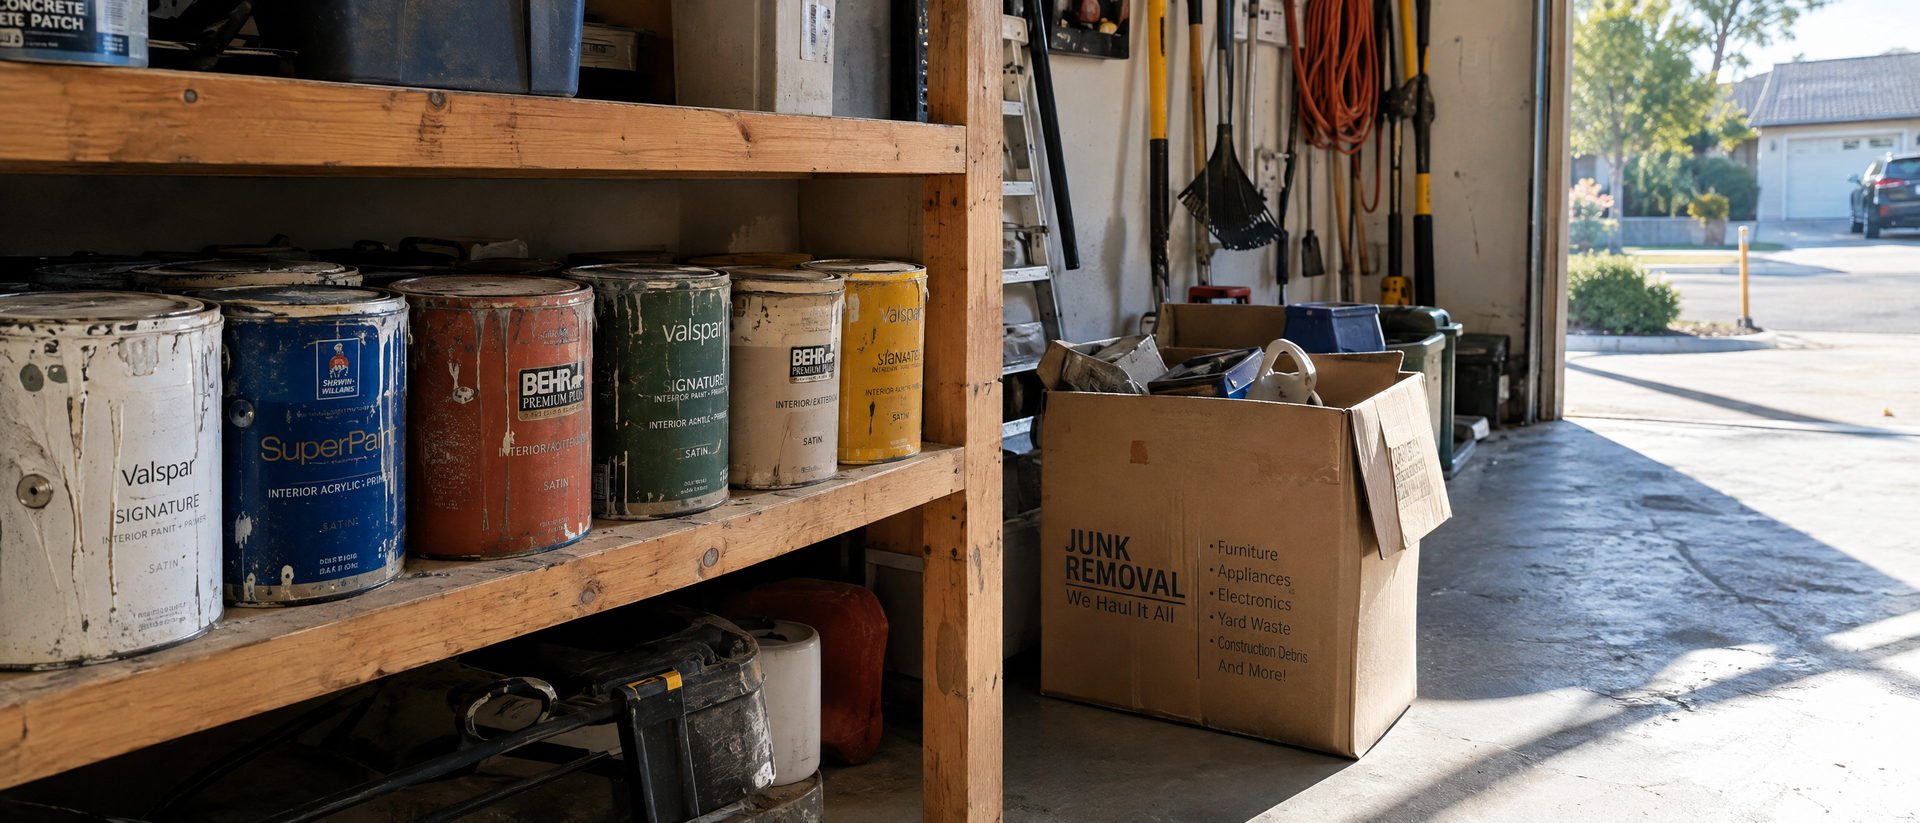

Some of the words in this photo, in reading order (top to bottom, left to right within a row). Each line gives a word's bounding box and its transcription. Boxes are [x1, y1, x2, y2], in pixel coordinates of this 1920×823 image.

[31, 13, 84, 31] PATCH
[792, 347, 825, 366] BEHR
[522, 368, 571, 396] BEHR
[523, 393, 567, 408] PREMIUM
[569, 388, 584, 403] PLUS
[649, 419, 687, 429] INTERIOR
[892, 412, 910, 422] SATIN
[261, 424, 398, 465] SuperPaint
[803, 435, 823, 446] SATIN
[122, 459, 195, 486] Valspar
[268, 487, 318, 498] INTERIOR
[320, 480, 360, 495] ACRYLIC
[543, 478, 569, 491] SATIN
[116, 493, 200, 524] SIGNATURE
[102, 530, 148, 545] INTERIOR
[184, 514, 207, 528] PRIMER
[322, 518, 355, 532] SATIN
[1065, 528, 1131, 562] JUNK
[1218, 540, 1278, 561] Furniture
[148, 559, 179, 574] SATIN
[1066, 555, 1186, 599] REMOVAL
[1217, 564, 1291, 587] Appliances
[1066, 589, 1091, 608] We
[1096, 595, 1132, 616] Haul
[1138, 602, 1149, 619] It
[1153, 605, 1174, 623] All
[1218, 587, 1292, 611] Electronics
[1218, 611, 1247, 629] Yard
[1251, 616, 1291, 636] Waste
[1218, 636, 1276, 658] Construction
[1278, 645, 1308, 664] Debris
[1218, 659, 1244, 675] And
[1248, 662, 1287, 682] More!
